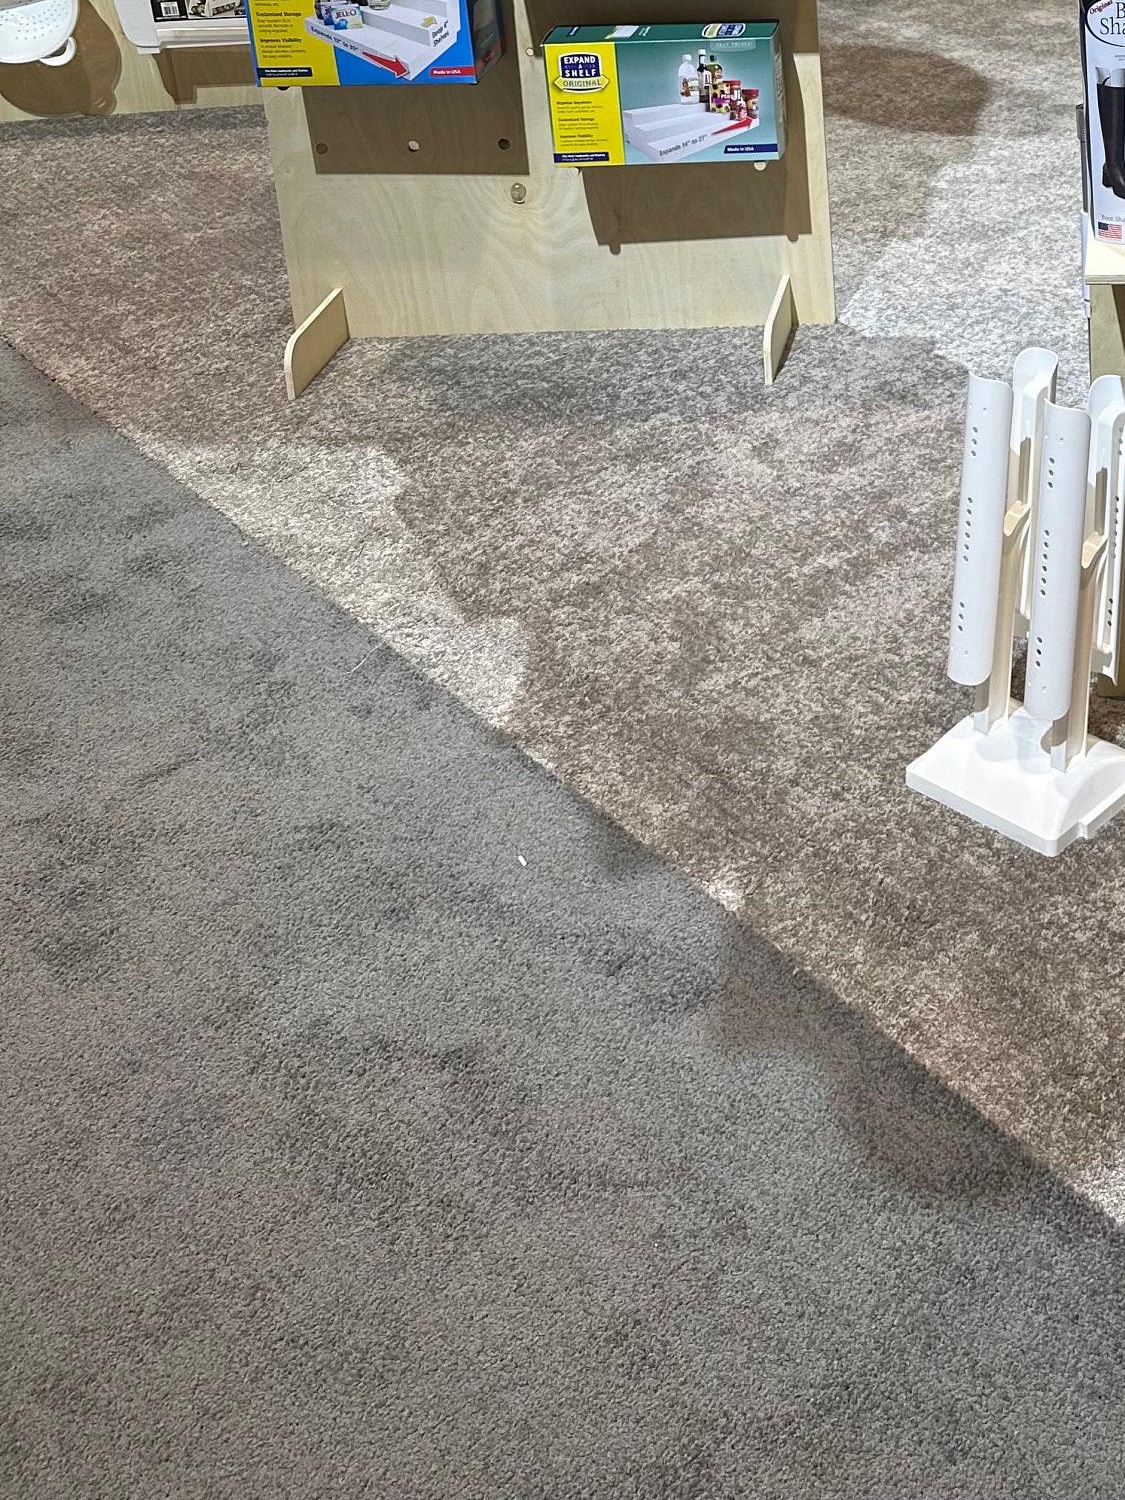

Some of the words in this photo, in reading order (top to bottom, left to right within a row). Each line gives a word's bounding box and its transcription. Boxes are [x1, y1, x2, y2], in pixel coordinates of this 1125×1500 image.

[1089, 0, 1114, 16] Original
[564, 56, 596, 64] EXPAND
[565, 69, 597, 77] SHELF
[562, 79, 604, 87] ORIGINAL
[659, 145, 681, 156] Expands
